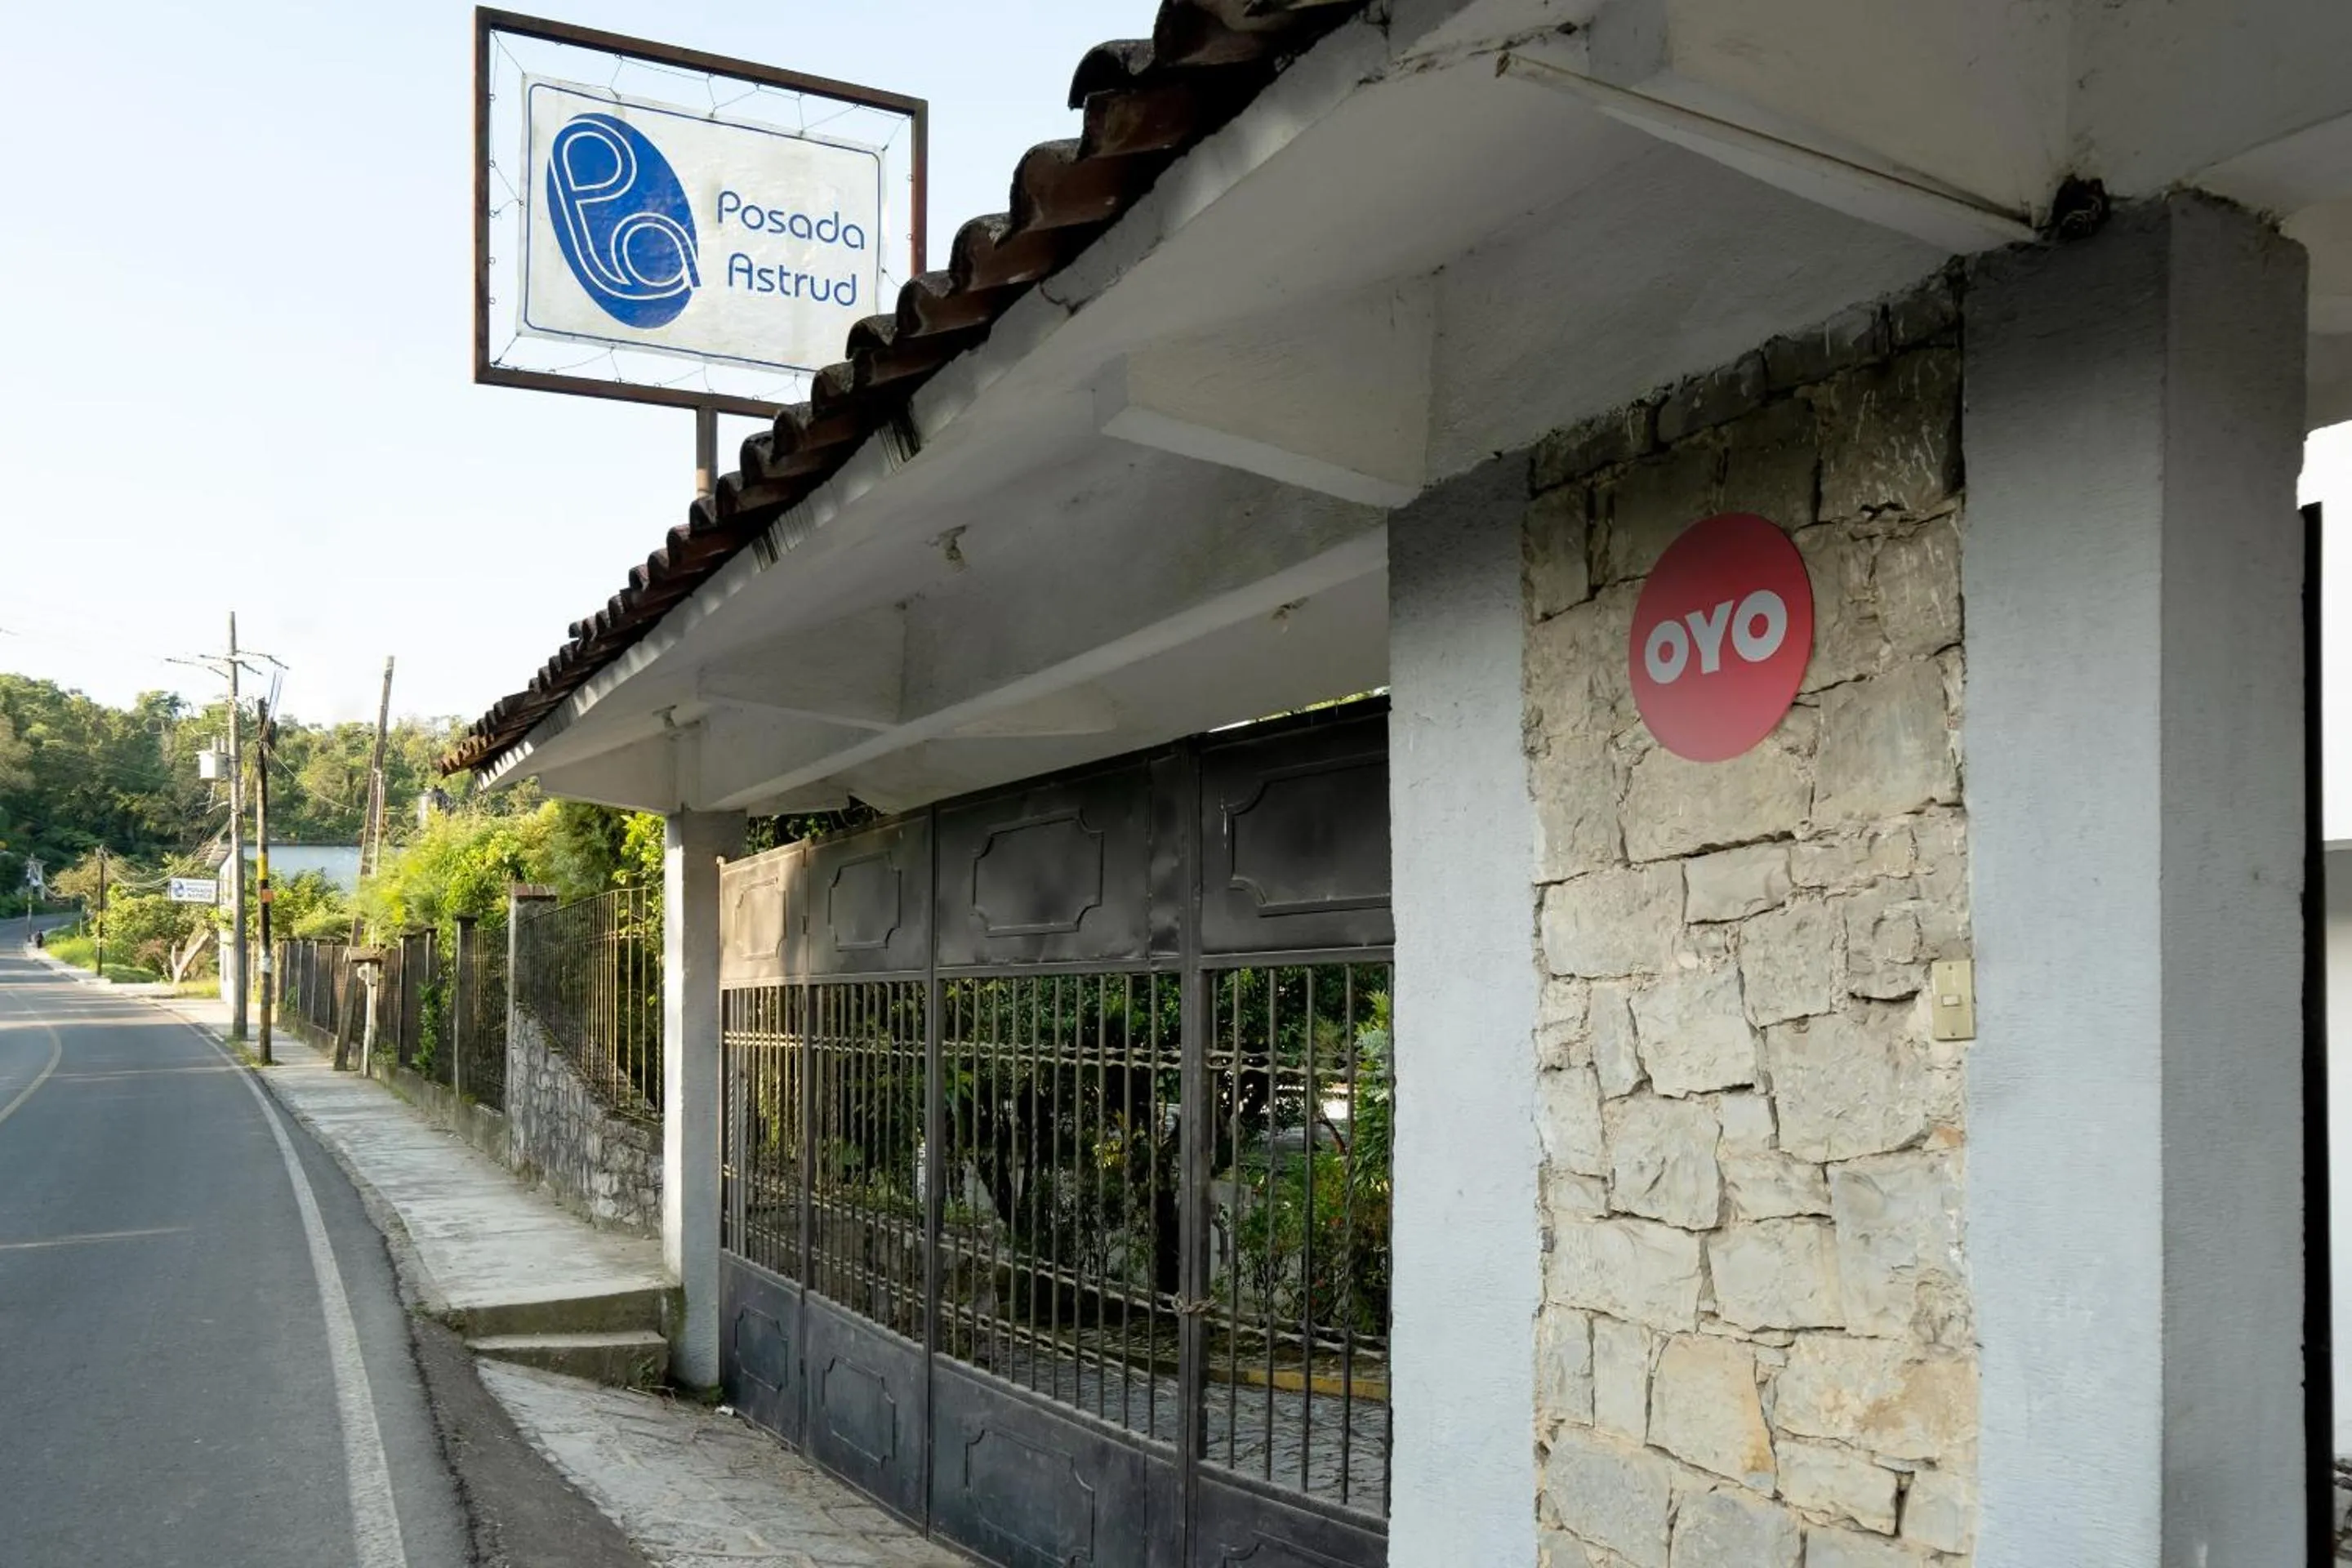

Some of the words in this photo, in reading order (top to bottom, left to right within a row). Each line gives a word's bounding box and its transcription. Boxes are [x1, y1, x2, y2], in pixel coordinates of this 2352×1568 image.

[718, 191, 864, 250] Posada
[728, 252, 856, 306] Astrud
[1645, 589, 1787, 684] OYO
